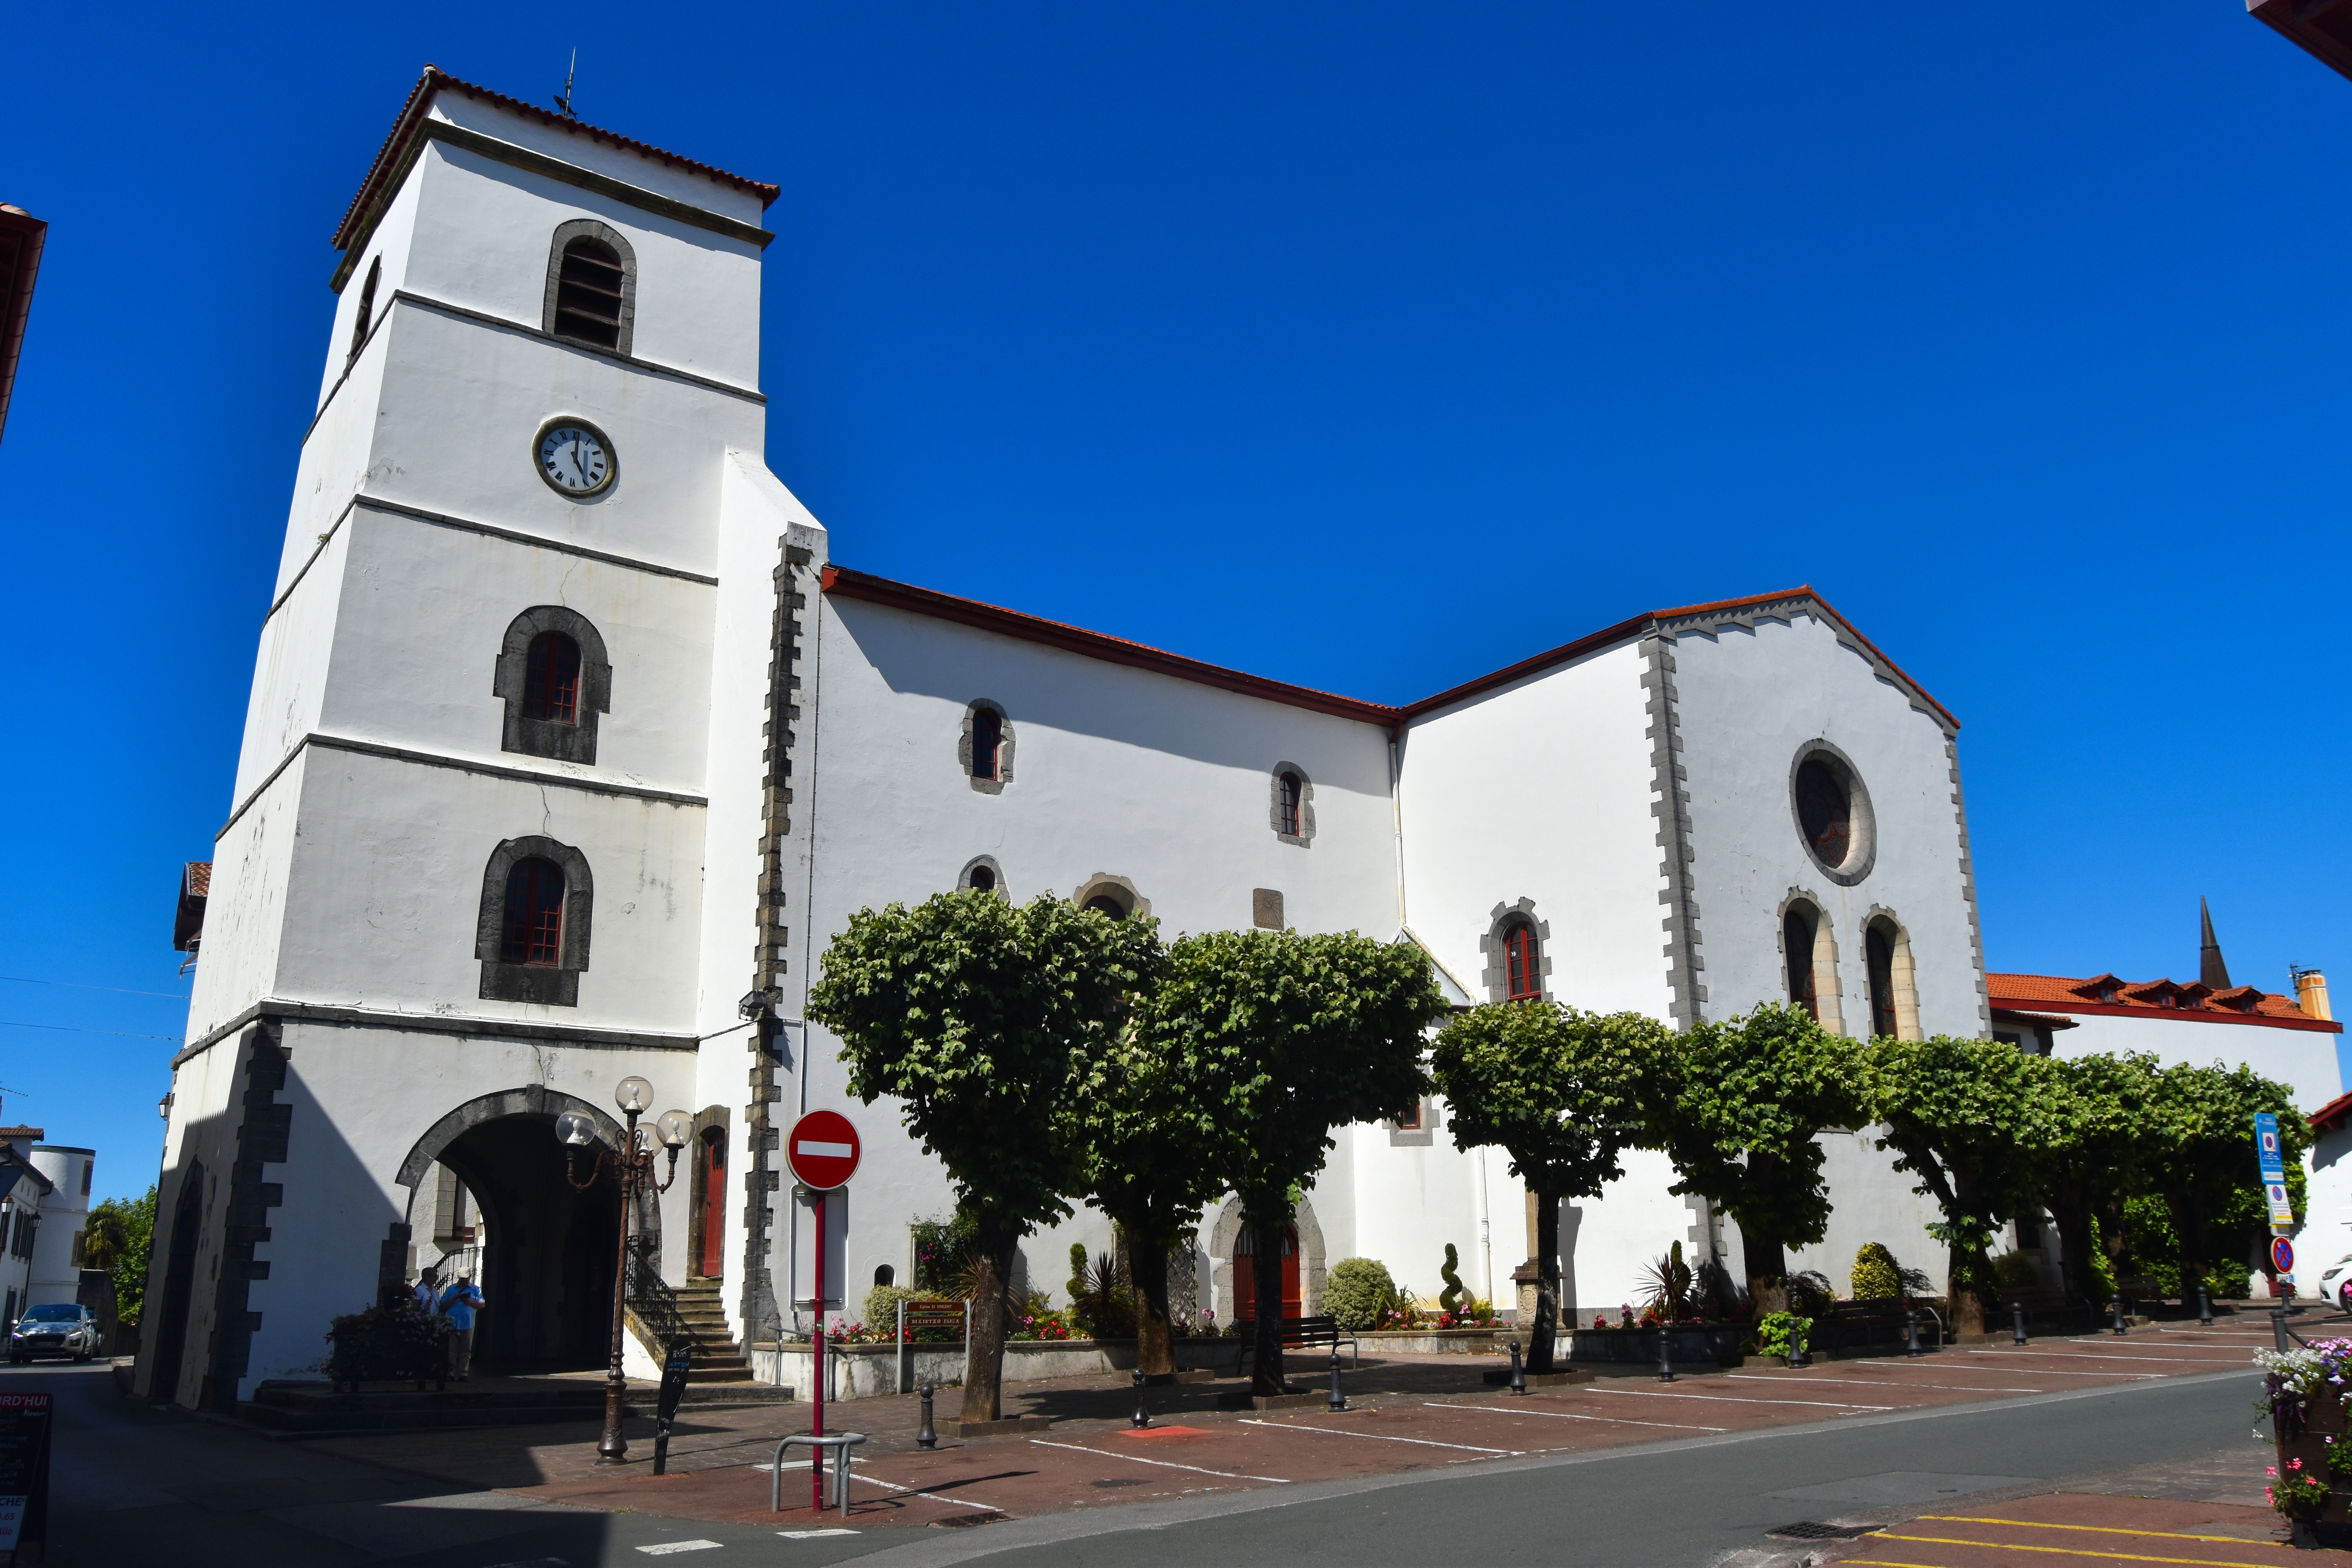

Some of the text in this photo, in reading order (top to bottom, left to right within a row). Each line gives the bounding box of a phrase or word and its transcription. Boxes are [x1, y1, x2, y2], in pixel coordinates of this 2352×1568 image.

[559, 430, 568, 441] XI
[548, 437, 558, 446] X
[546, 461, 557, 471] VIII
[555, 471, 564, 482] VII
[570, 477, 575, 488] VI
[0, 1396, 48, 1406] RD'HUI
